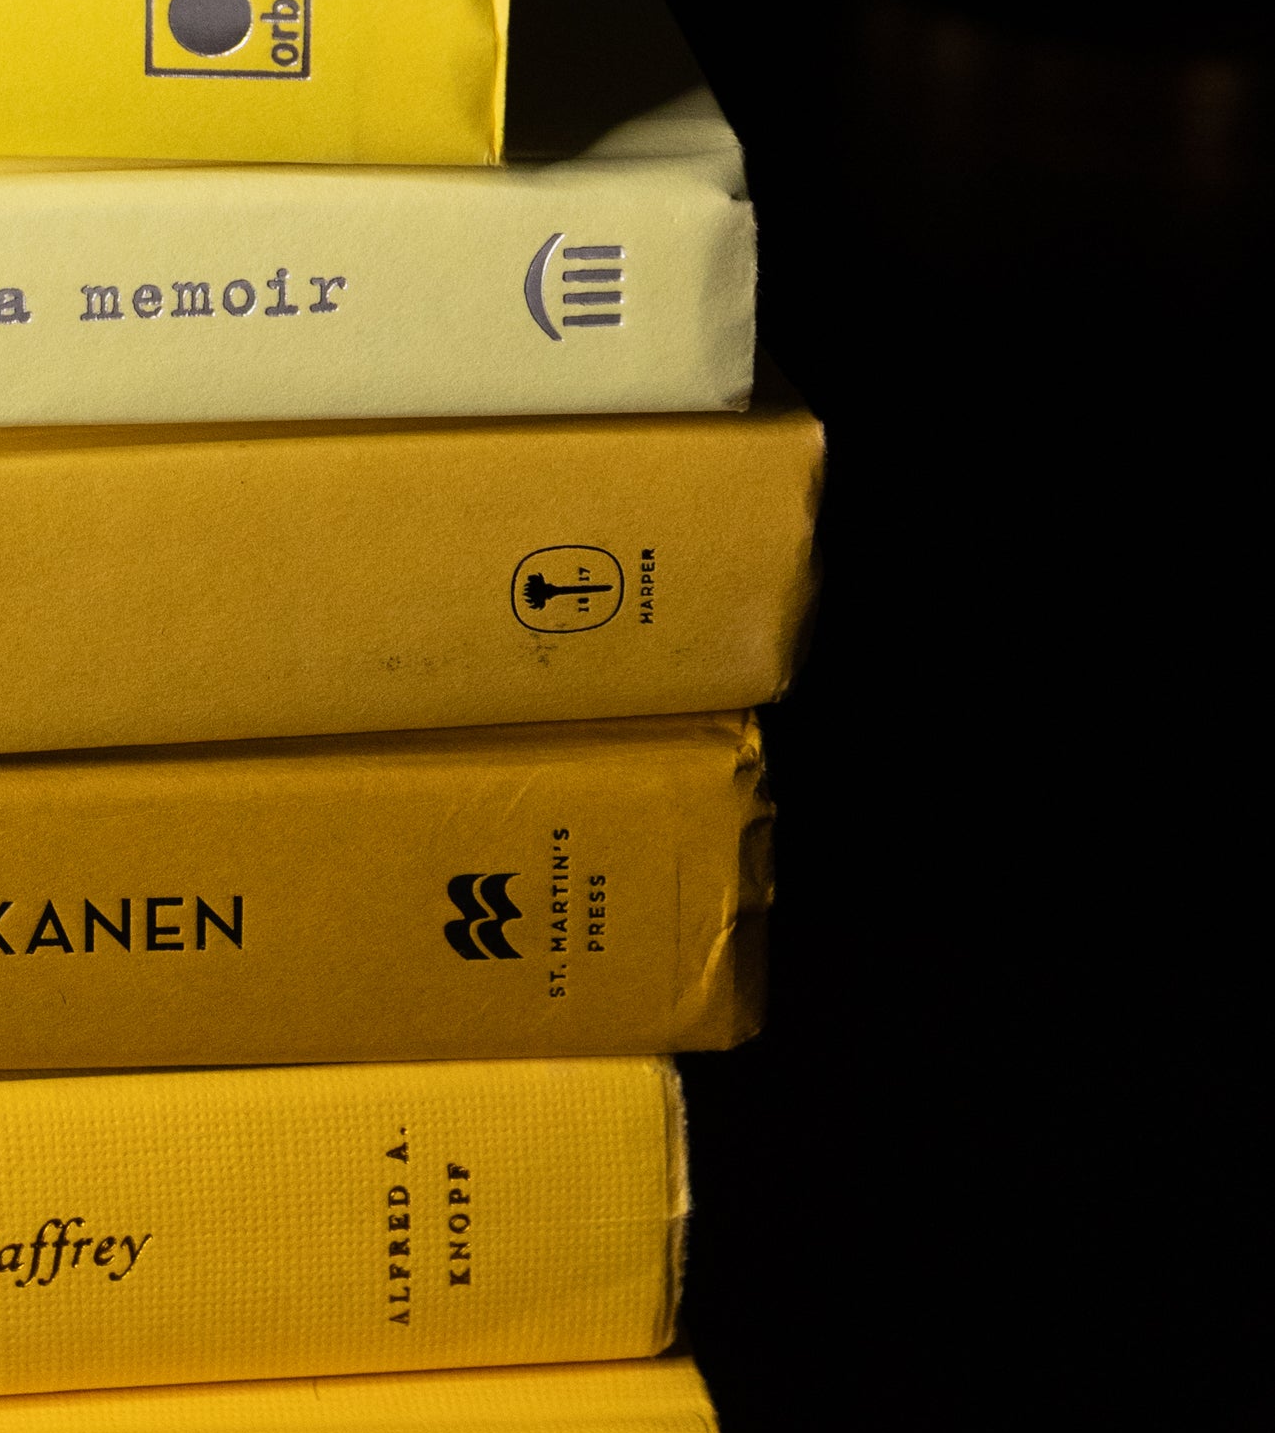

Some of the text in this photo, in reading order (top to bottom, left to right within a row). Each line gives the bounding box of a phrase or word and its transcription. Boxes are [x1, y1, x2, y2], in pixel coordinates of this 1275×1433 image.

[79, 267, 348, 323] memoir
[640, 548, 655, 624] HARPER
[550, 828, 570, 998] ST. MARTIN'S
[587, 875, 606, 952] PRESS
[386, 1127, 411, 1326] ALFRED A.
[448, 1163, 471, 1285] KNOPF
